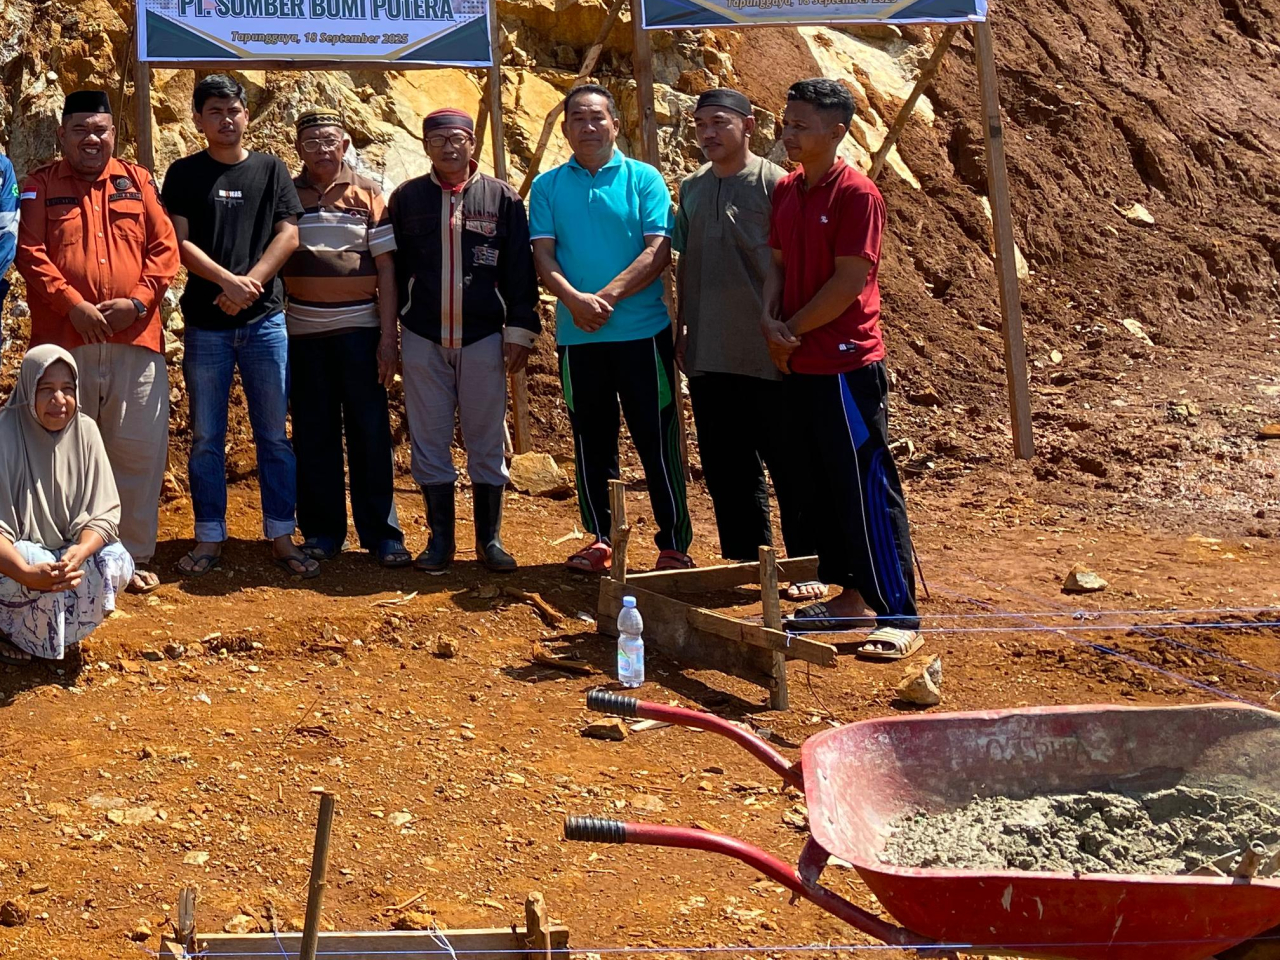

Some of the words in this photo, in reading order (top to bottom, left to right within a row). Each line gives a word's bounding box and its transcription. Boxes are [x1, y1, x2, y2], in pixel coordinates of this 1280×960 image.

[231, 31, 300, 45] Tapunggaya,
[304, 32, 318, 43] 18
[319, 33, 379, 44] September
[382, 34, 408, 44] 2025
